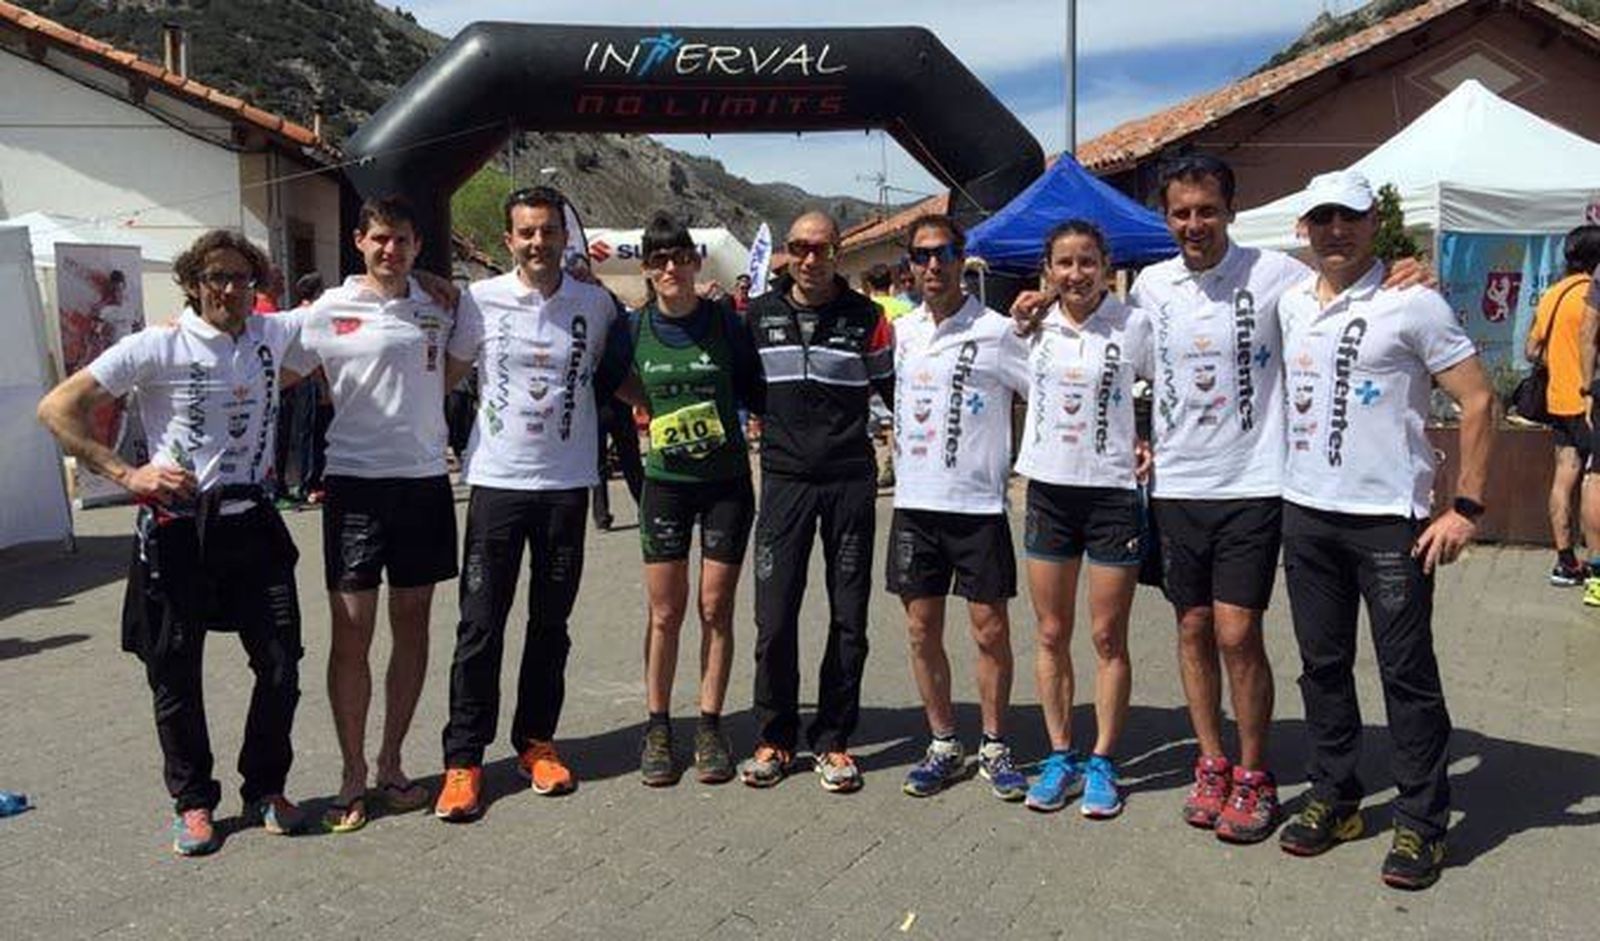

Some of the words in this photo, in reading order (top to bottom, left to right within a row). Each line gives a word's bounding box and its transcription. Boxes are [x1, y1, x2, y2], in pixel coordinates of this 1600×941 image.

[576, 94, 642, 115] NO
[558, 315, 588, 442] Cifuentes
[945, 340, 978, 469] Cifuentes
[1095, 342, 1121, 454] Cifuentes
[1235, 289, 1255, 431] Cifuentes
[1329, 317, 1368, 467] Cifuentes
[664, 420, 708, 445] 210
